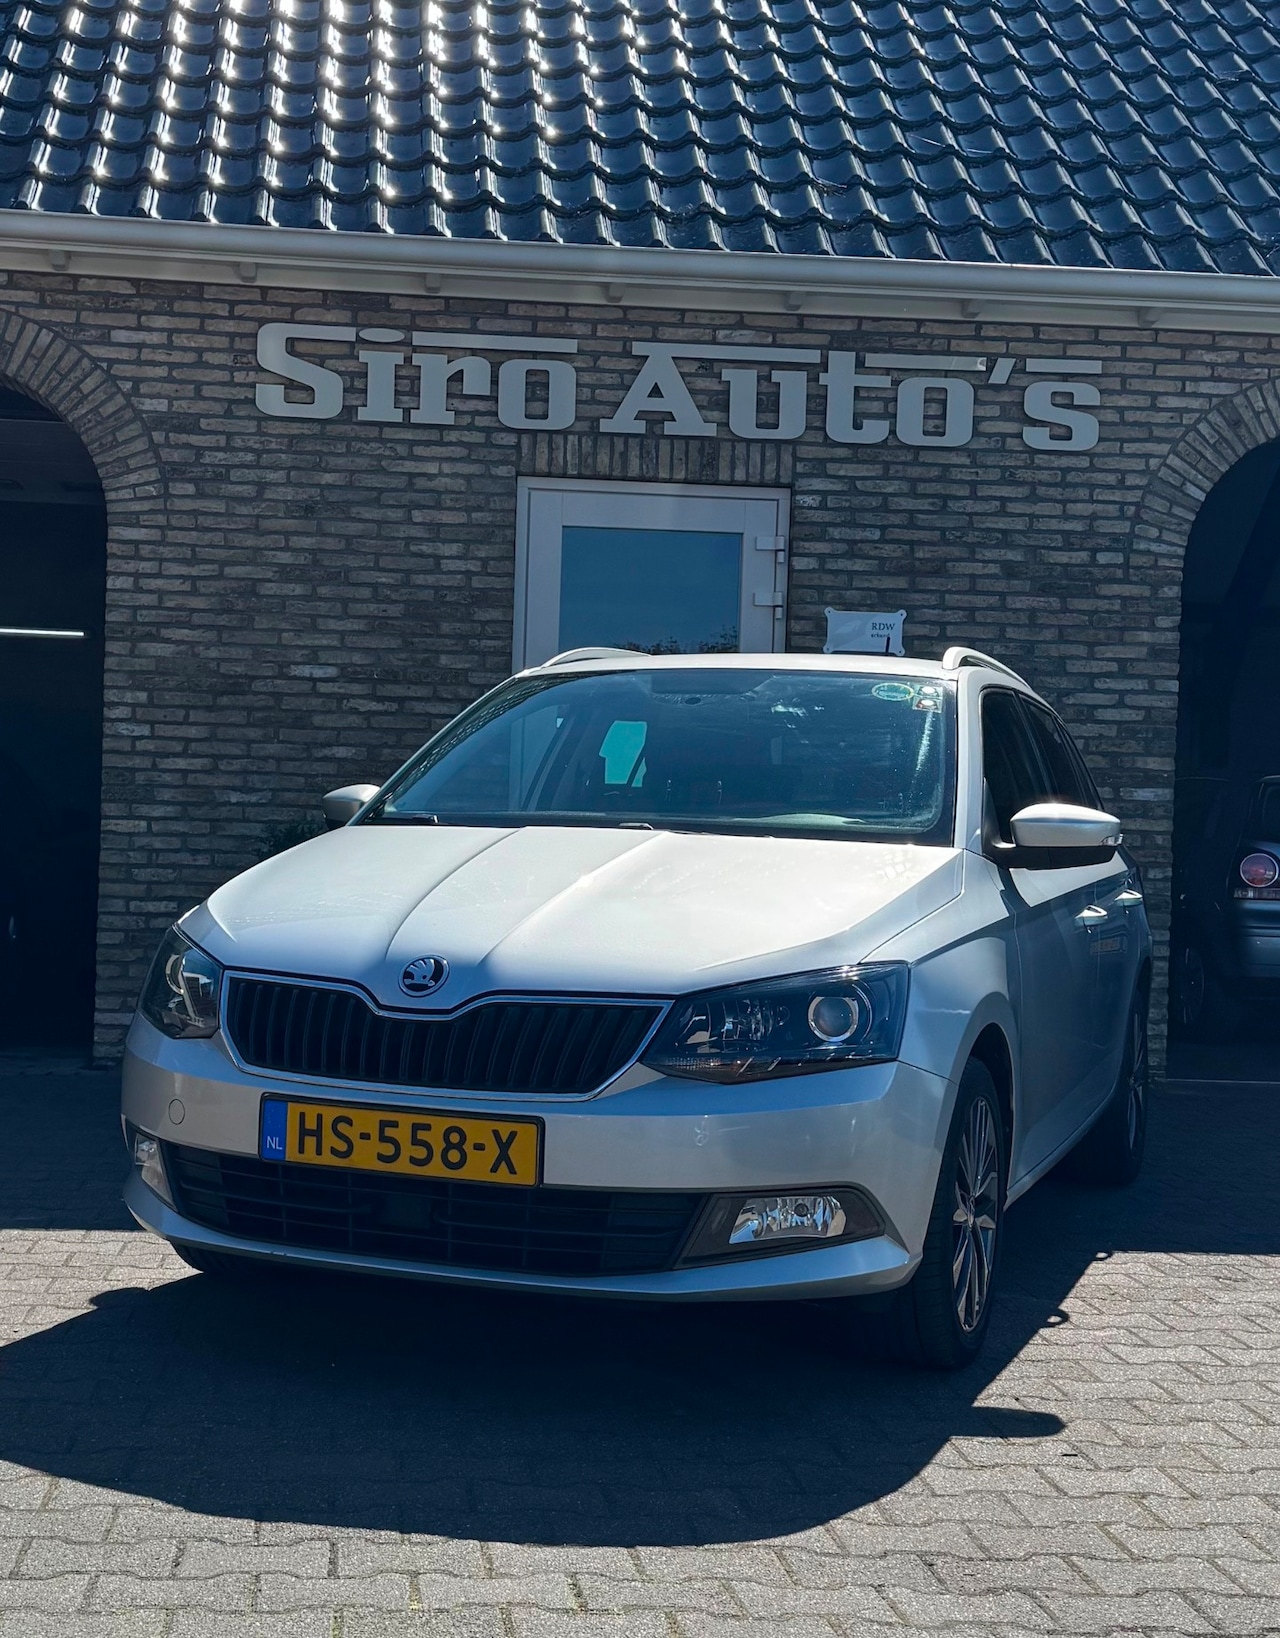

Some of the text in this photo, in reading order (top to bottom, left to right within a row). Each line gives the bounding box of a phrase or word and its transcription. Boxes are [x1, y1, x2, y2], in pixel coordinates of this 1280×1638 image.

[256, 322, 1102, 451] Siro Auto's
[871, 622, 895, 631] RDW
[266, 1135, 283, 1150] NL
[298, 1111, 518, 1175] HS-558-X
